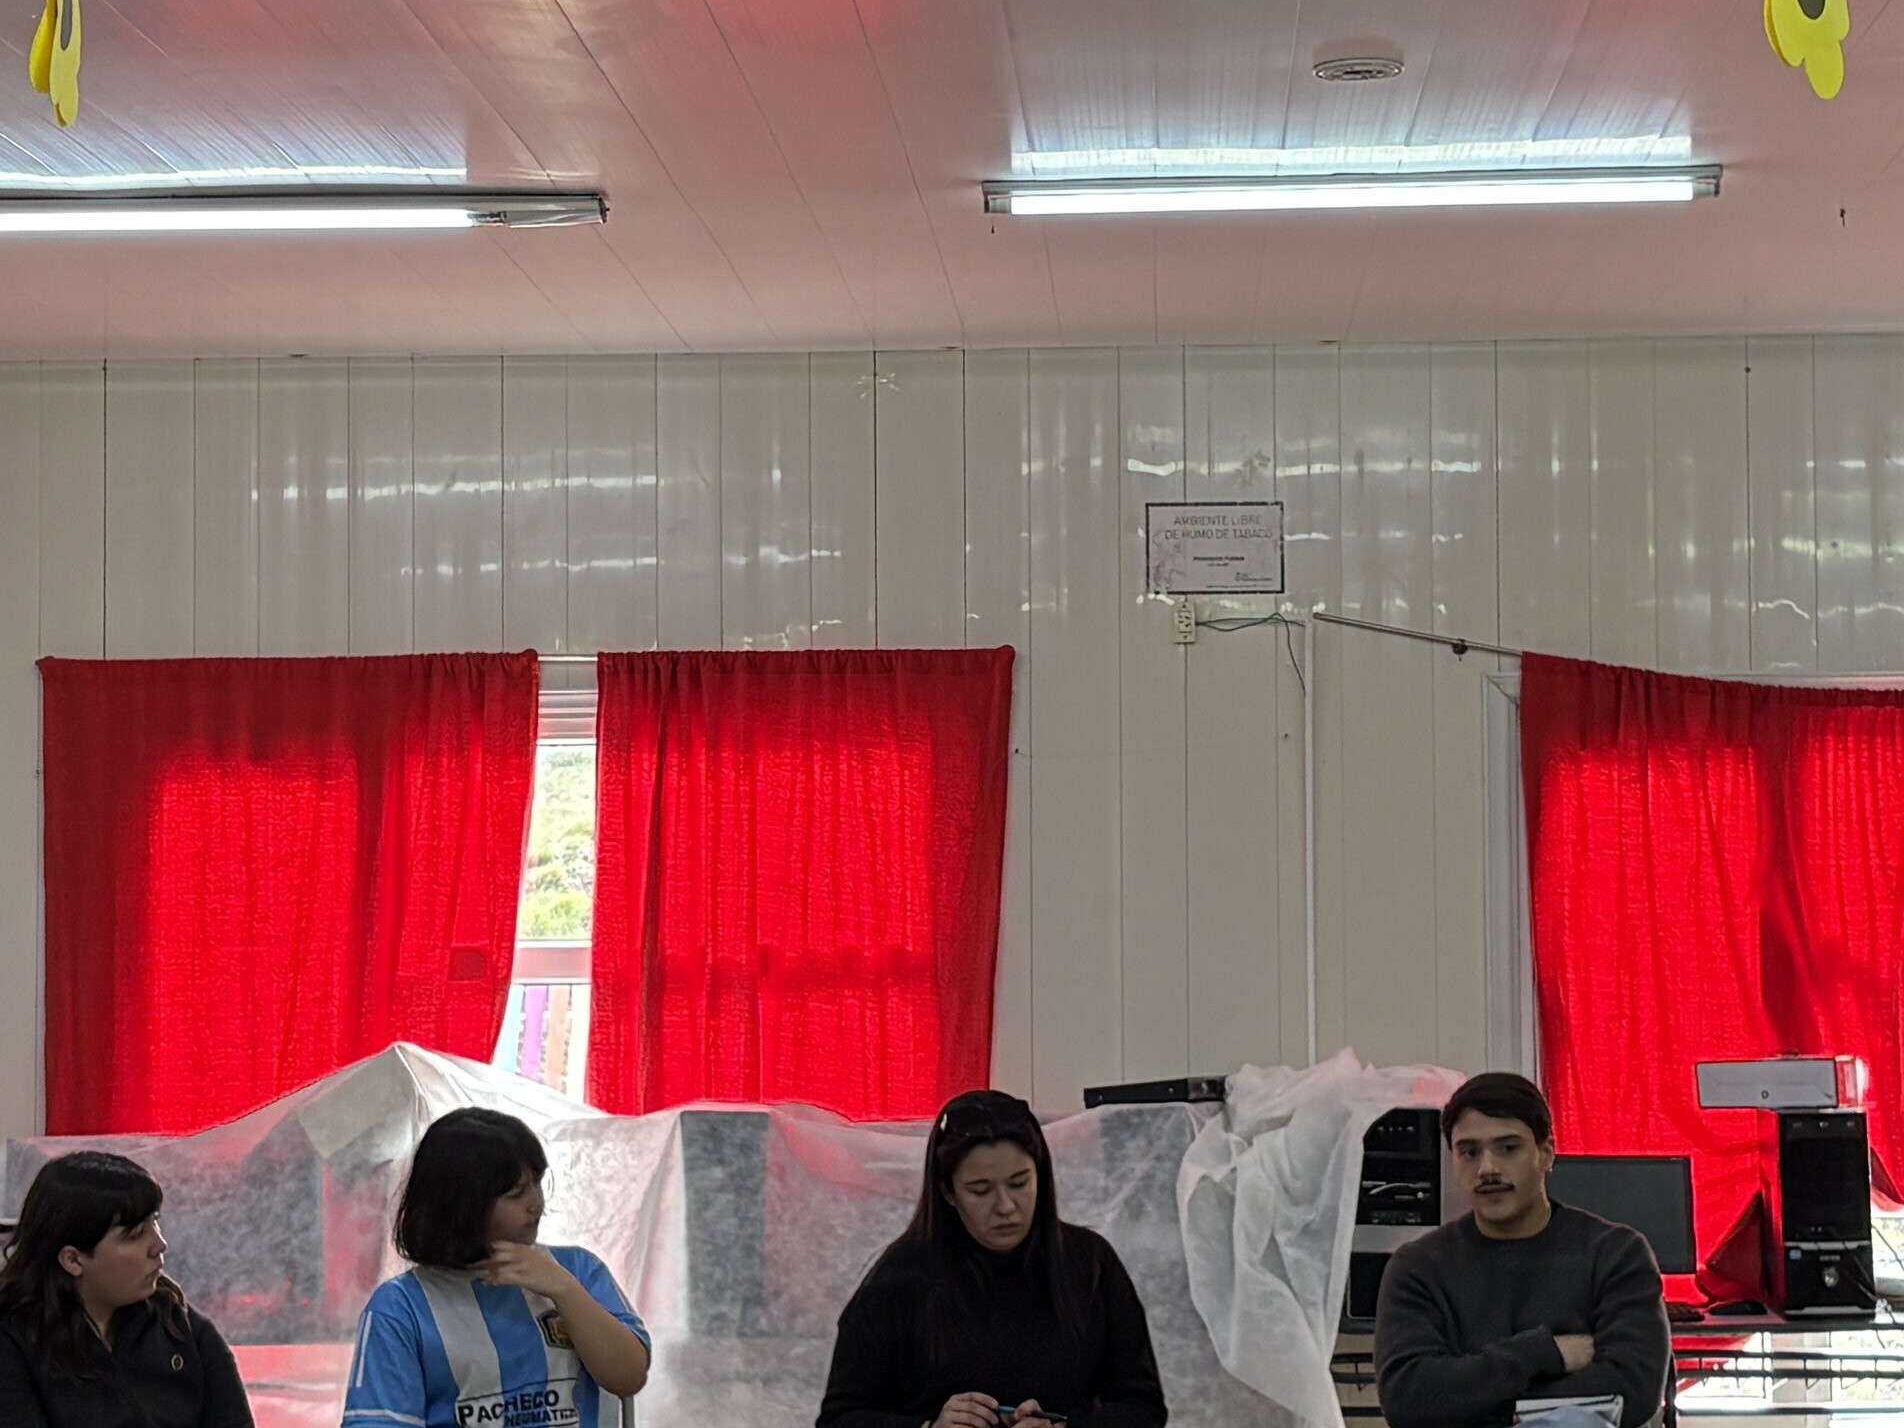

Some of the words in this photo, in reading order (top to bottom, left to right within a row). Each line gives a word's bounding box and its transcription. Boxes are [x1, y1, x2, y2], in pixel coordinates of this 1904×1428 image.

[1174, 515, 1229, 526] AMBIENTE
[1231, 514, 1263, 525] LIBRE
[1164, 529, 1179, 540] DE
[1182, 529, 1214, 540] HUMO
[1215, 529, 1228, 539] DE
[457, 1389, 560, 1426] PACHECO
